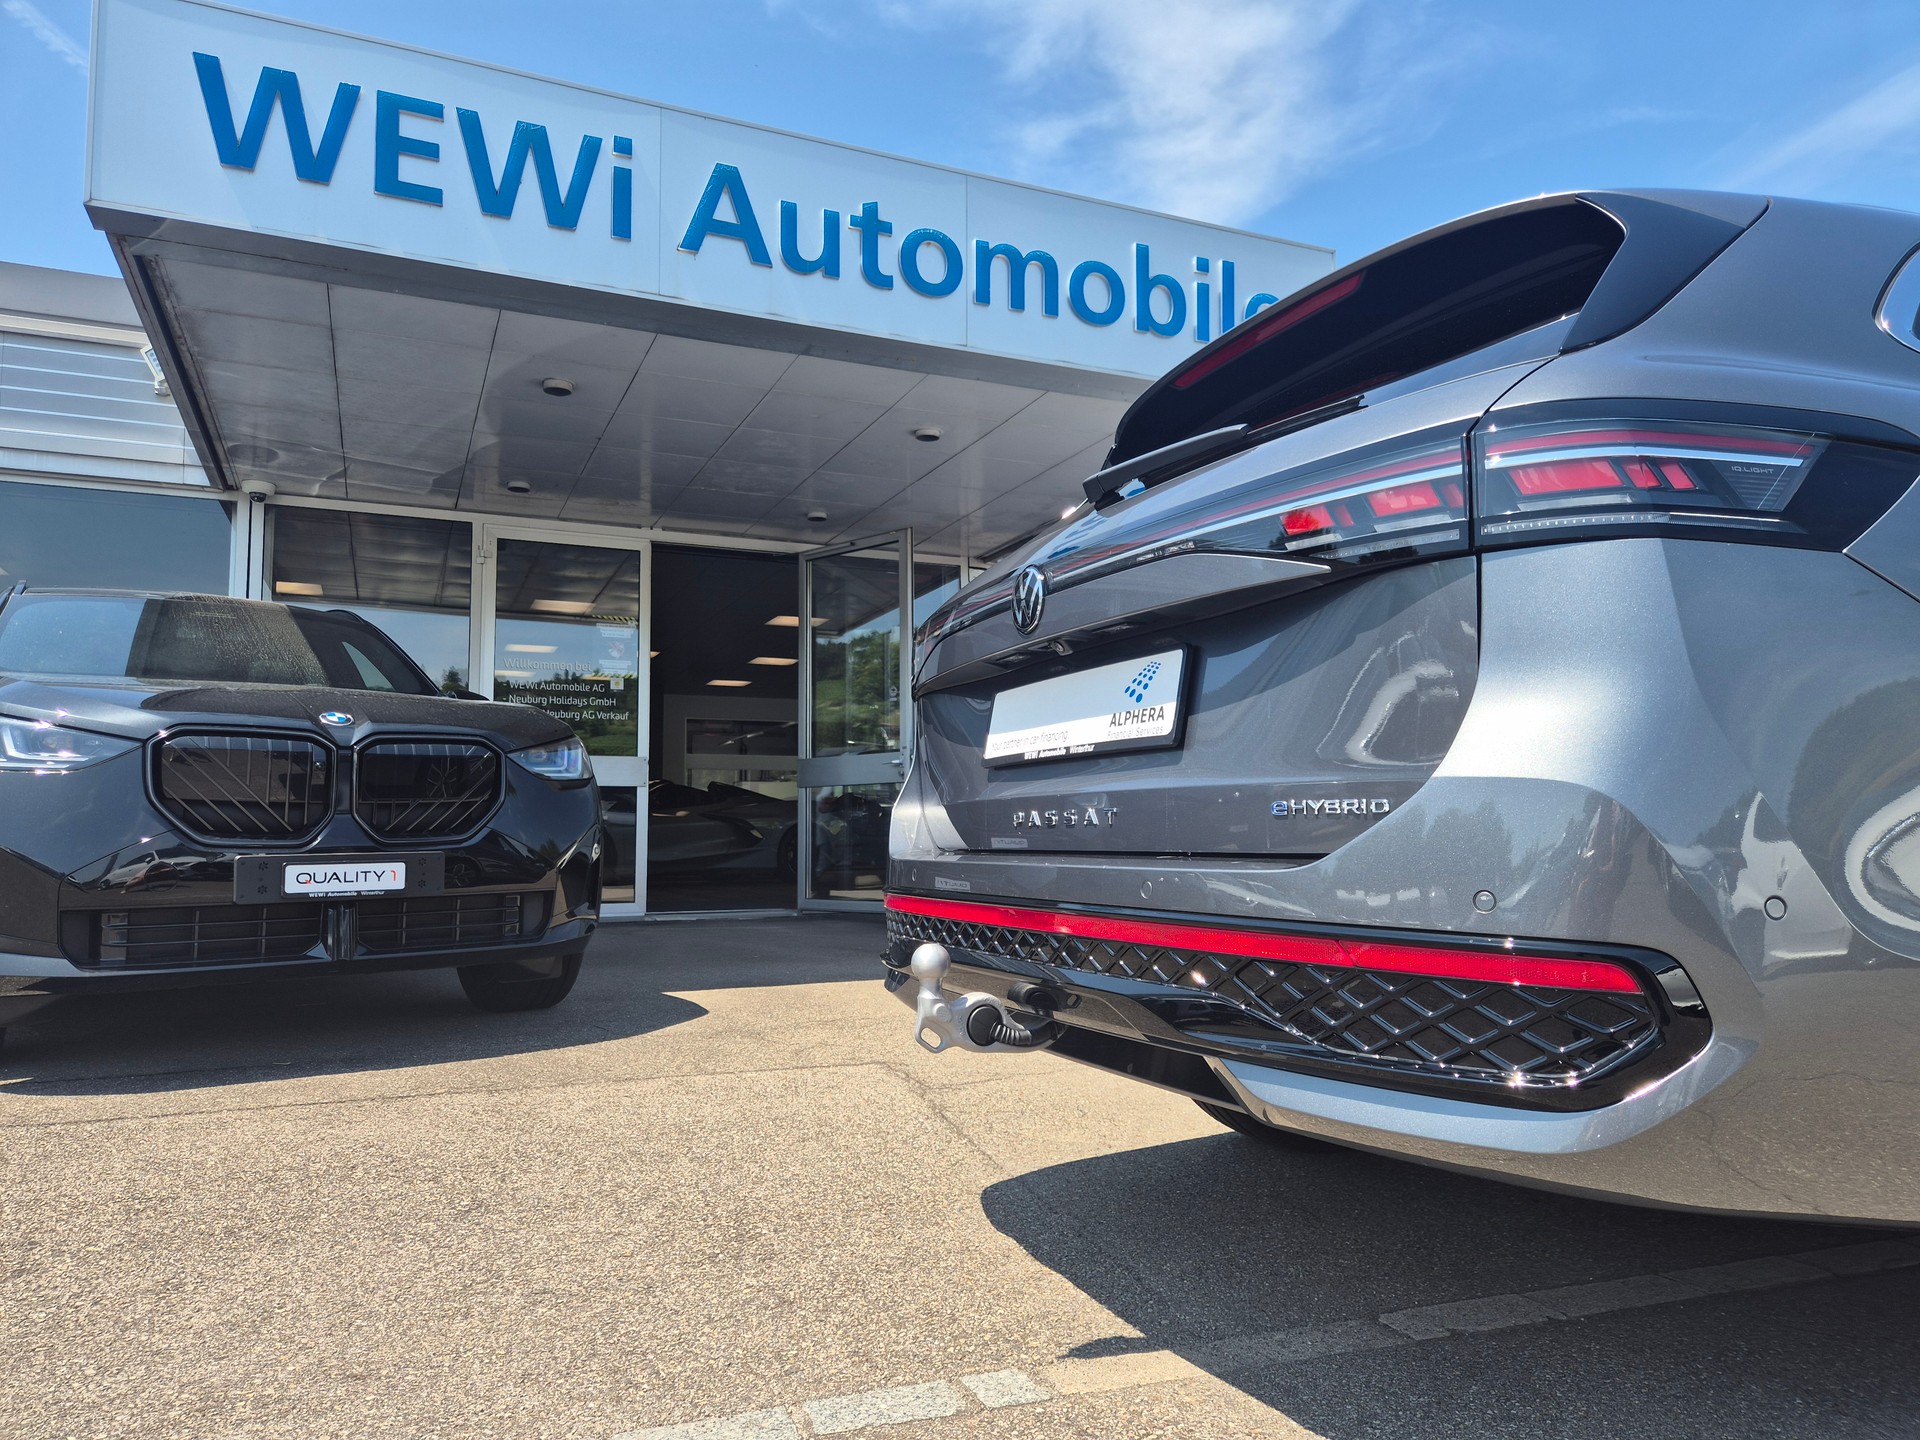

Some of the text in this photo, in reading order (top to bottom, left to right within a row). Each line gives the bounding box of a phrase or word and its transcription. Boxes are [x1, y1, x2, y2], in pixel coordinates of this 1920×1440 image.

[192, 51, 633, 242] WEWi
[1731, 465, 1775, 474] IQ.LIGHT
[504, 658, 573, 671] Willkommen
[575, 661, 592, 672] bei
[540, 682, 591, 692] Automobile
[592, 683, 605, 693] AG
[508, 694, 617, 707] Neuburg Holidays GmbH
[582, 711, 595, 720] AG
[596, 711, 630, 721] Verkauf
[1109, 706, 1164, 728] ALPHERA
[1135, 726, 1164, 737] Services
[1271, 799, 1390, 816] eHYBRID
[1013, 808, 1118, 828] PASSAT
[296, 870, 397, 885] QUALITY 1
